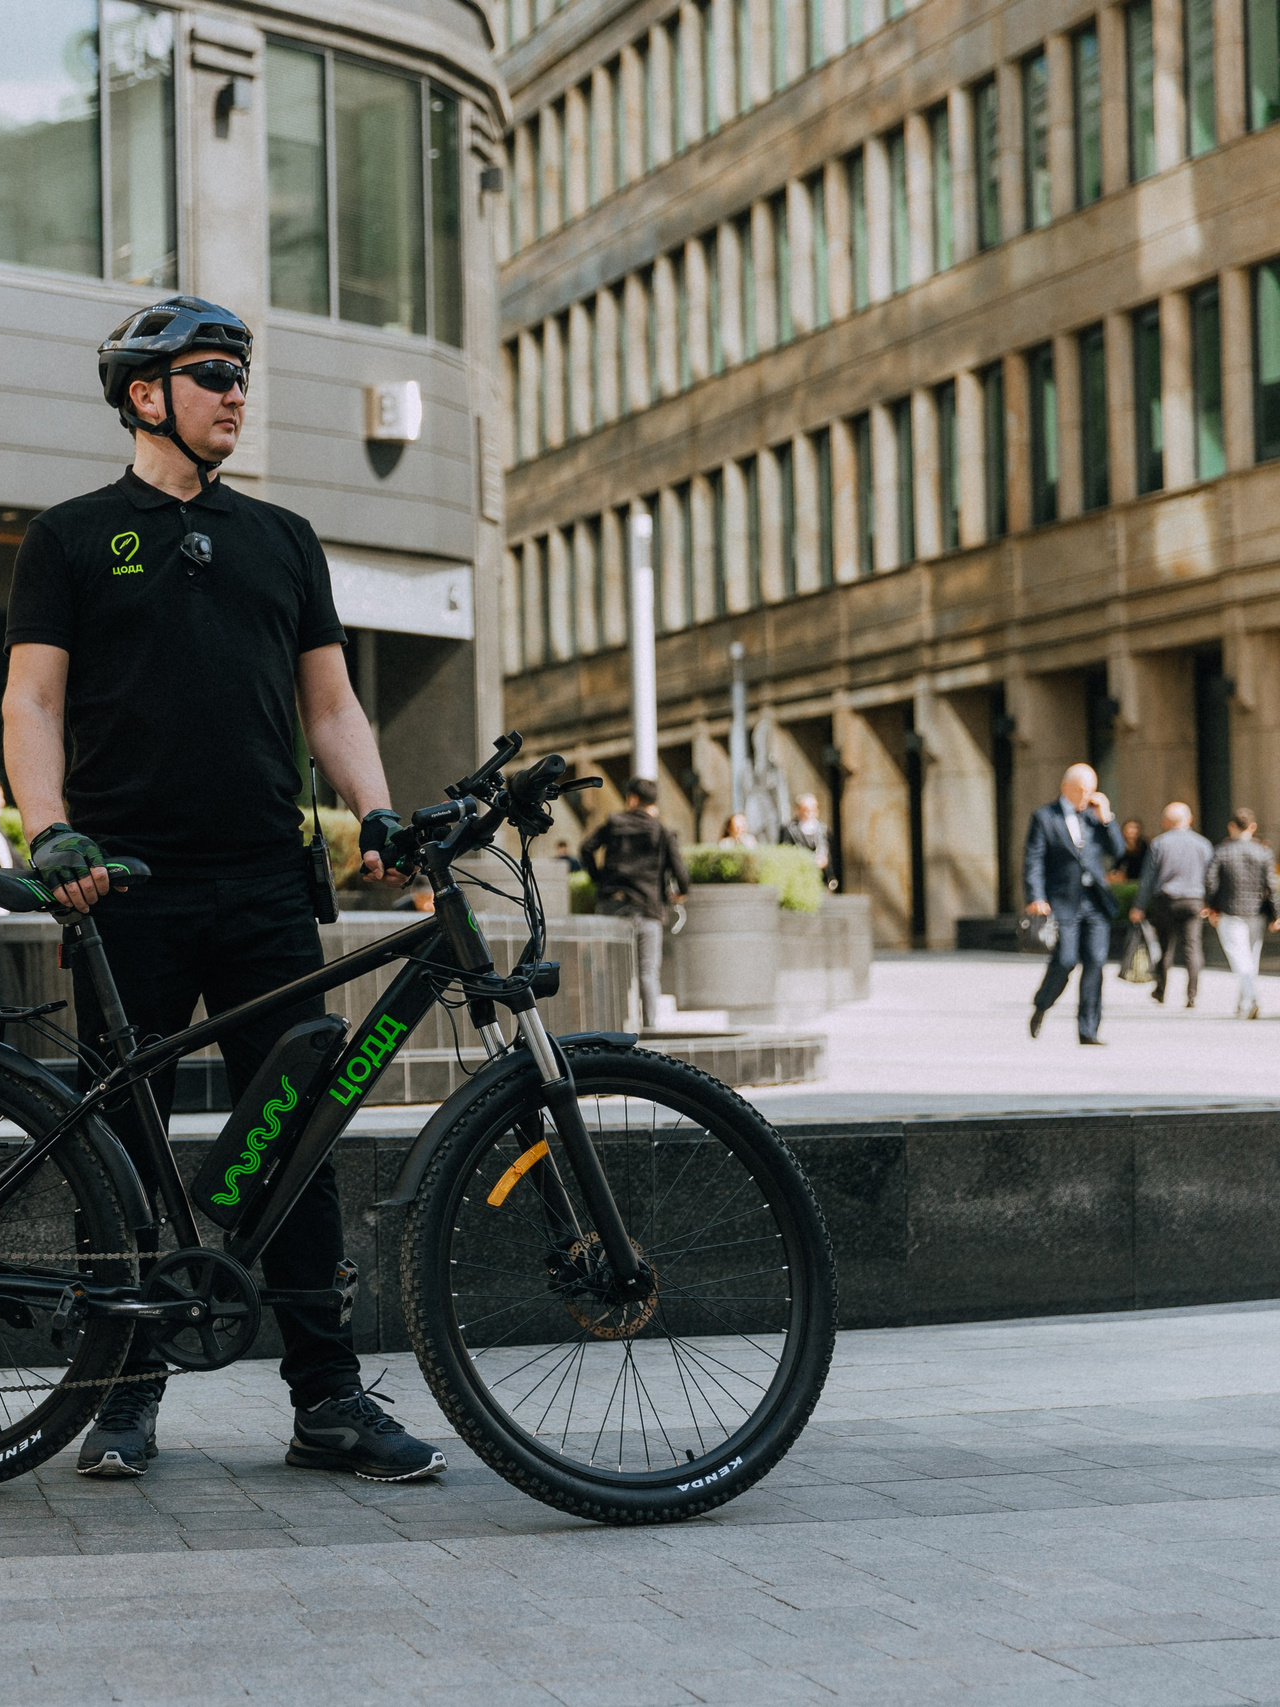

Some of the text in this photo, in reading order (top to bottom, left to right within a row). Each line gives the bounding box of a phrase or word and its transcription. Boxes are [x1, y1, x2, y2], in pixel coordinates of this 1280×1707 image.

[112, 564, 144, 575] ЦОДД
[328, 1013, 408, 1106] ЦОДД
[676, 1455, 743, 1492] KENDA
